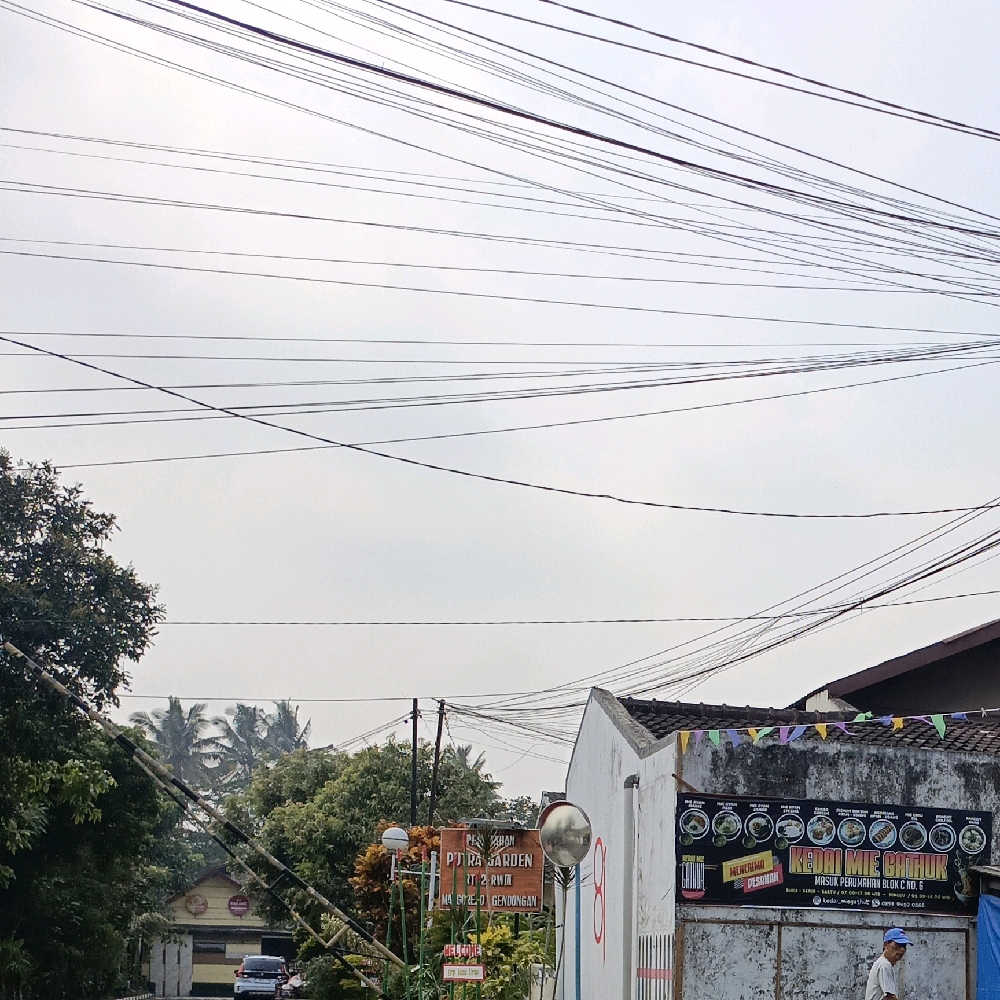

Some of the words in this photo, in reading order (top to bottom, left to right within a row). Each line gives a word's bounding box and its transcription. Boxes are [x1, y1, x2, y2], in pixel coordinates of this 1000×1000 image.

[789, 846, 842, 875] KEDAI
[845, 848, 880, 878] MIE
[883, 851, 948, 881] GATHUK
[814, 876, 839, 887] MASUK
[840, 877, 881, 889] PERUMAHAN
[882, 879, 899, 890] BLOK
[900, 879, 906, 890] C
[918, 880, 924, 891] 6
[441, 894, 485, 906] MAGOREO
[491, 894, 537, 907] GENDONGAN
